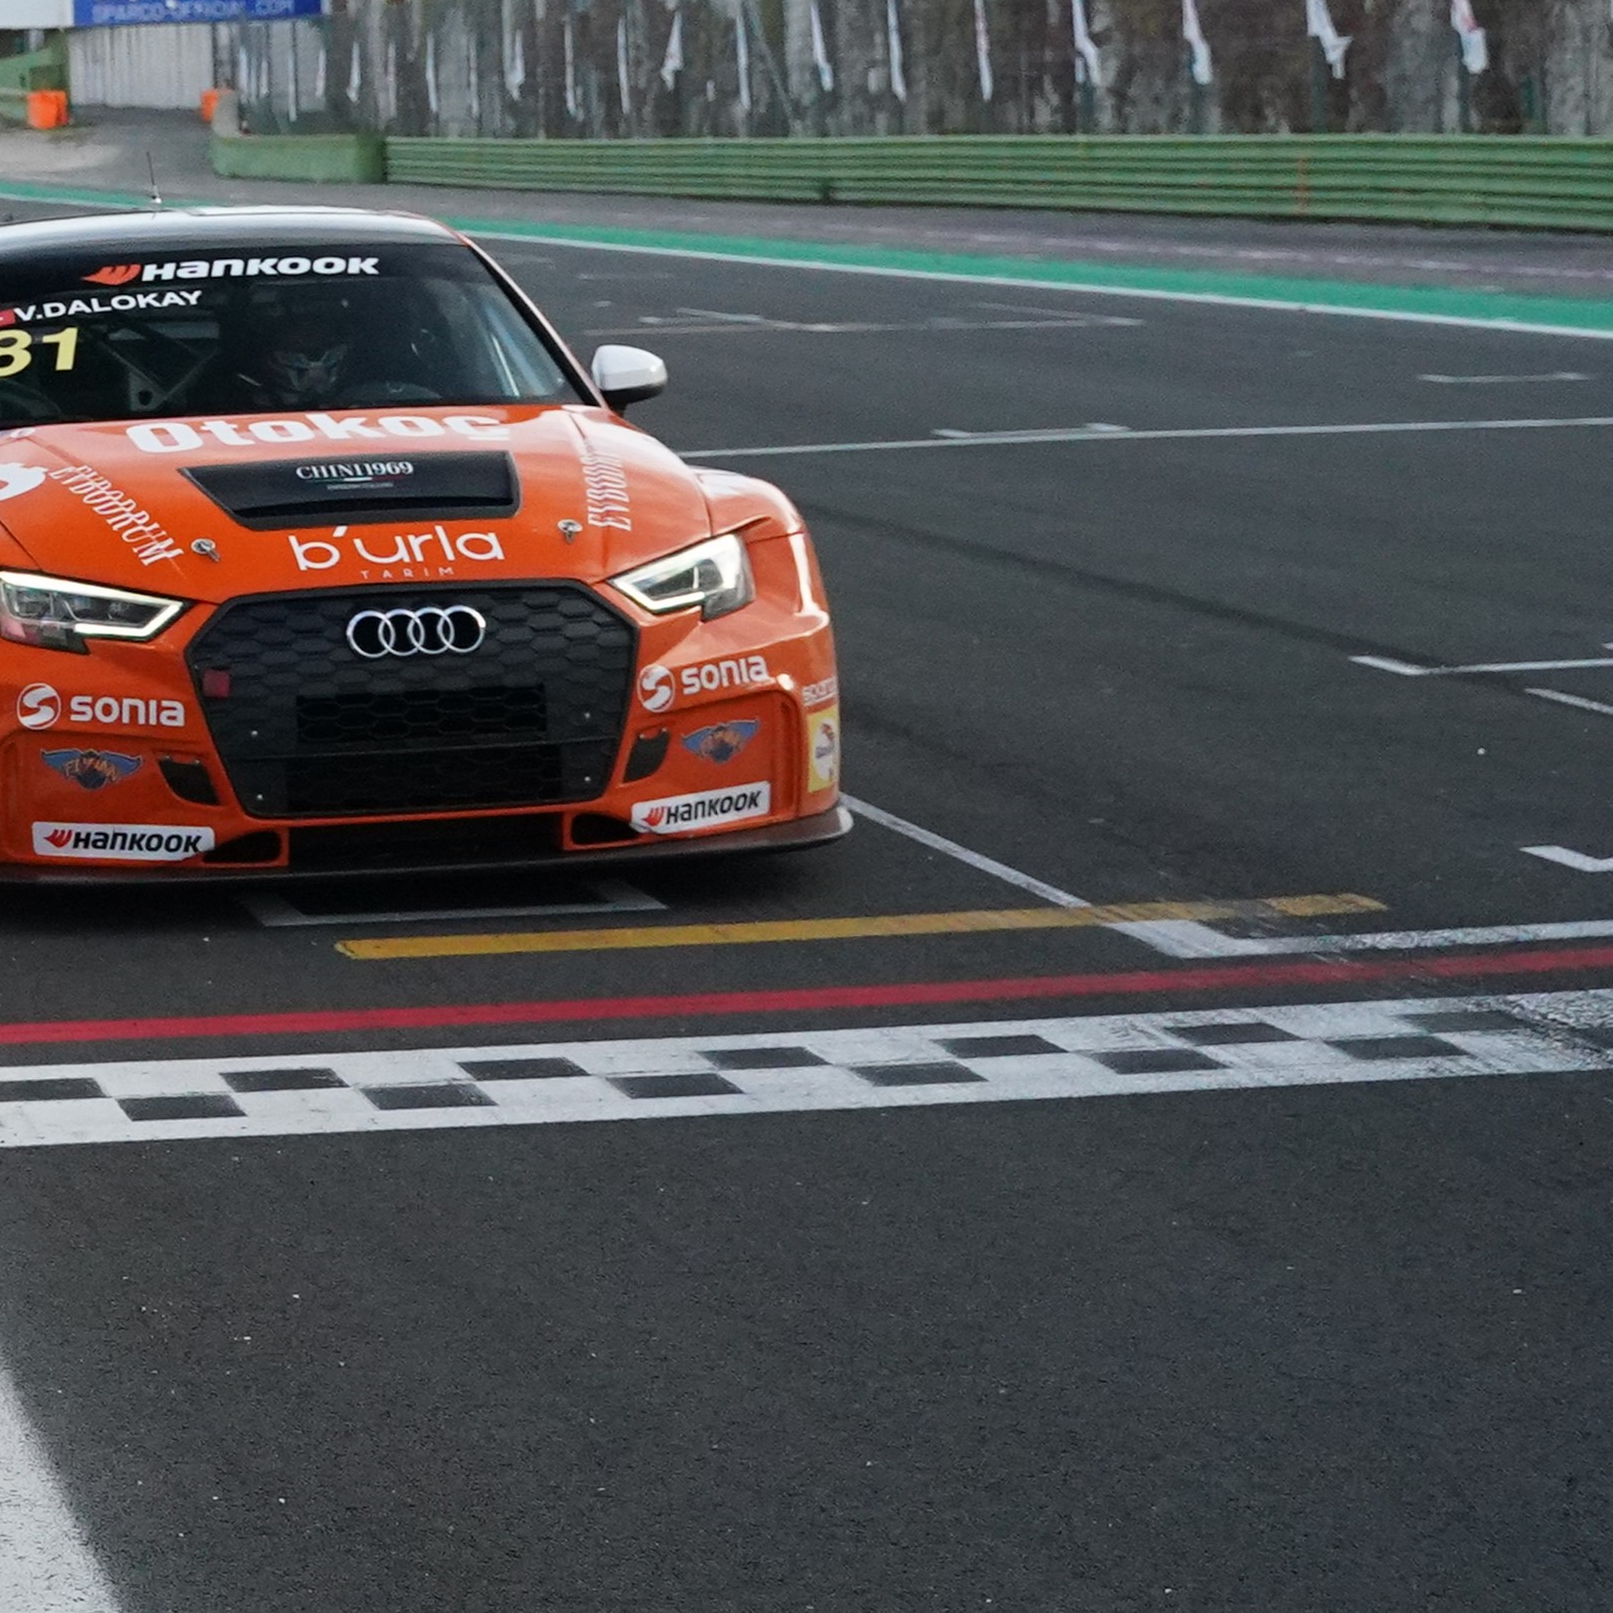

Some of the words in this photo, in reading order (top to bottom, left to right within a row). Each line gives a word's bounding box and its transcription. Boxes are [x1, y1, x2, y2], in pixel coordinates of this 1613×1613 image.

[13, 289, 203, 323] V.DALOKAY
[360, 565, 455, 580] TARIM
[681, 654, 770, 695] sonia
[70, 694, 186, 727] sonia
